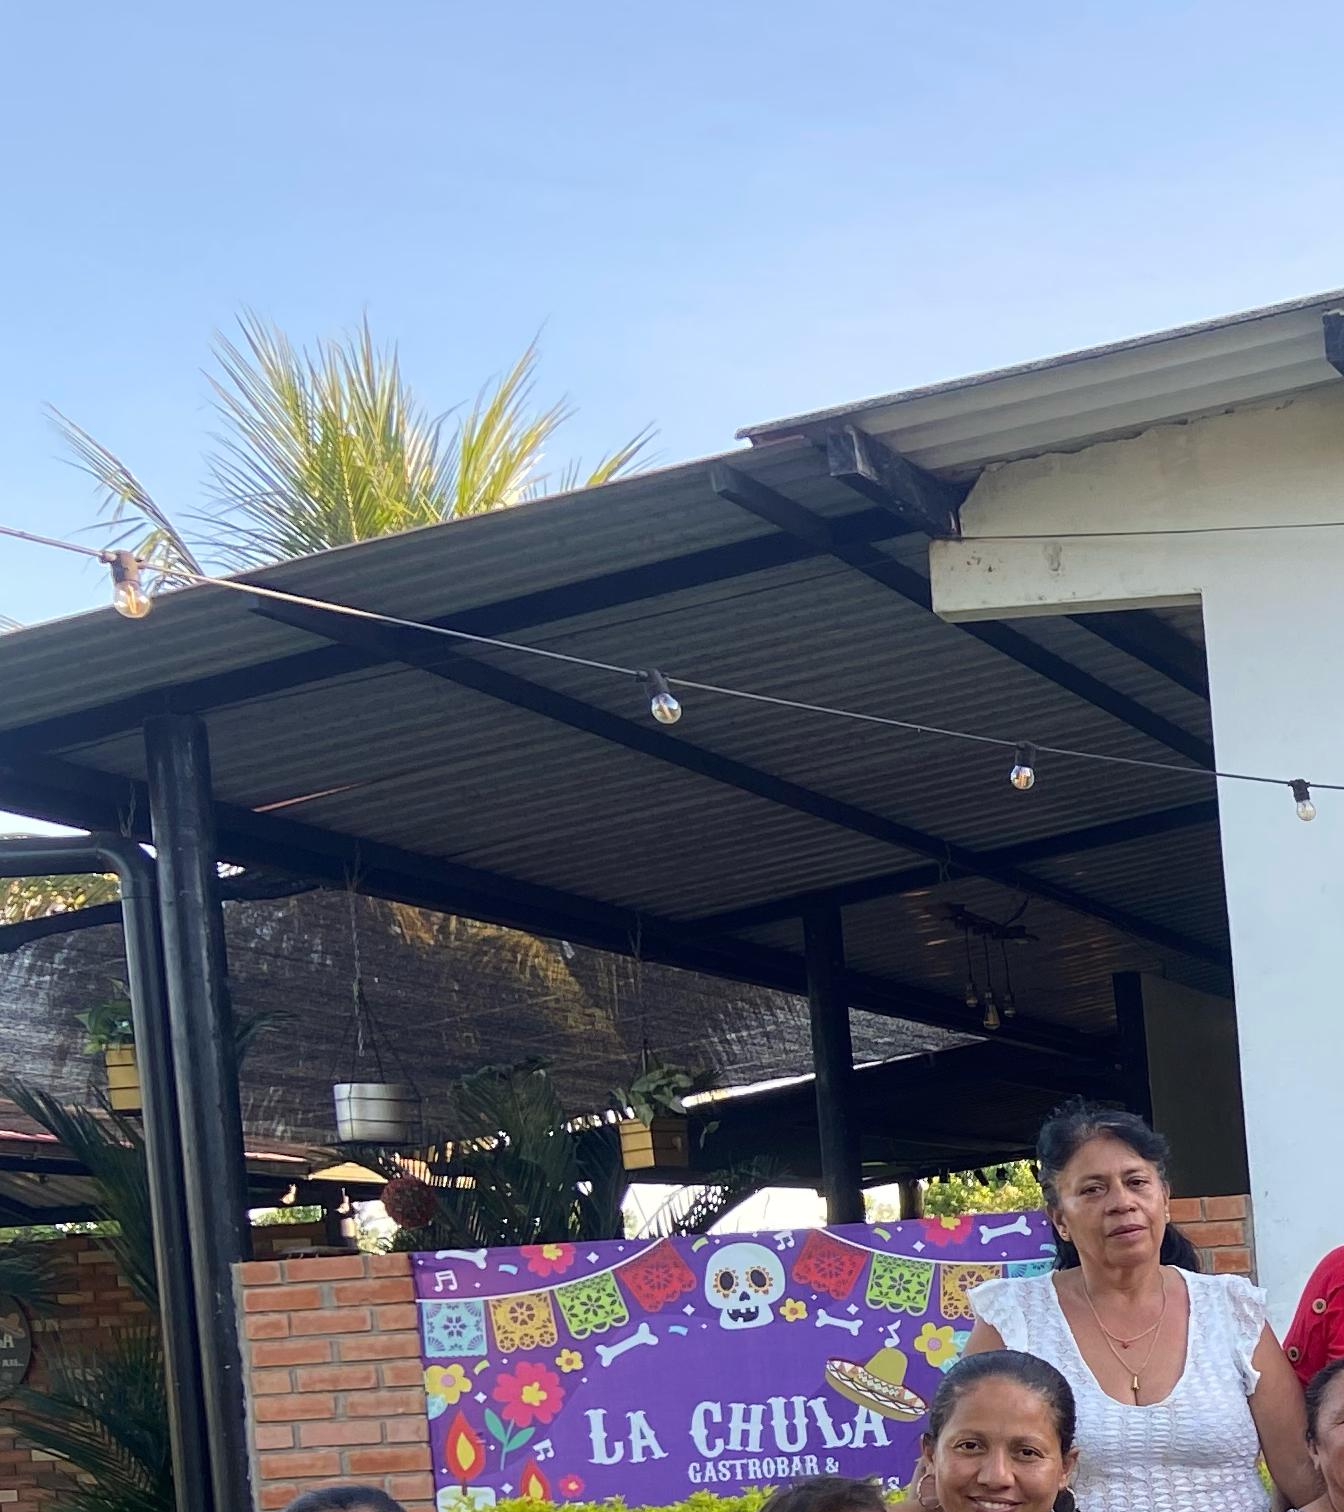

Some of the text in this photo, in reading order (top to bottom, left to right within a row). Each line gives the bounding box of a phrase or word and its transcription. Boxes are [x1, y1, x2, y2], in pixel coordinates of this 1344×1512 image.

[584, 1396, 893, 1465] LA CHULA
[688, 1454, 839, 1483] GASTROBAR &
